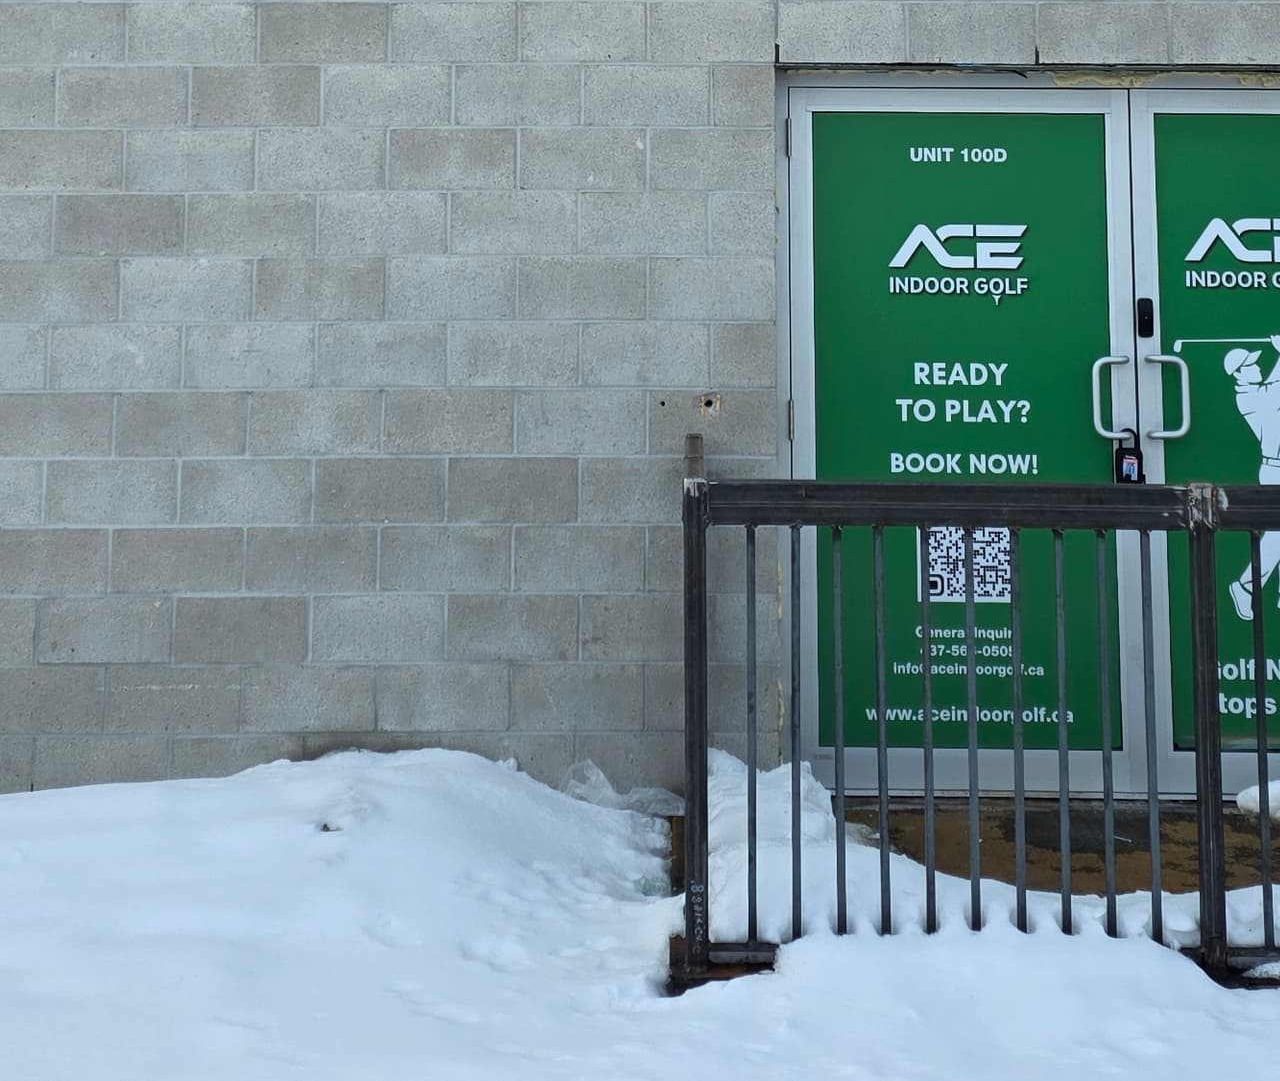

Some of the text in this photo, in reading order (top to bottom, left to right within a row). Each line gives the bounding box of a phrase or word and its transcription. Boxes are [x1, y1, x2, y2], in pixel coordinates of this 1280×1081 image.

[910, 147, 1008, 162] UNIT 100D
[888, 224, 1028, 269] ACE
[889, 276, 1028, 294] INDOOR GOLF
[1185, 270, 1267, 288] INDOOR
[914, 362, 1008, 386] READY
[895, 399, 1031, 423] TO PLAY?
[890, 453, 1038, 475] BOOK NOW!
[915, 625, 967, 638] Gnera
[920, 644, 1013, 657] 37-56-050
[1217, 658, 1255, 680] olf
[865, 705, 1074, 725] www.aceinoorolf.ca
[1218, 693, 1277, 719] tops
